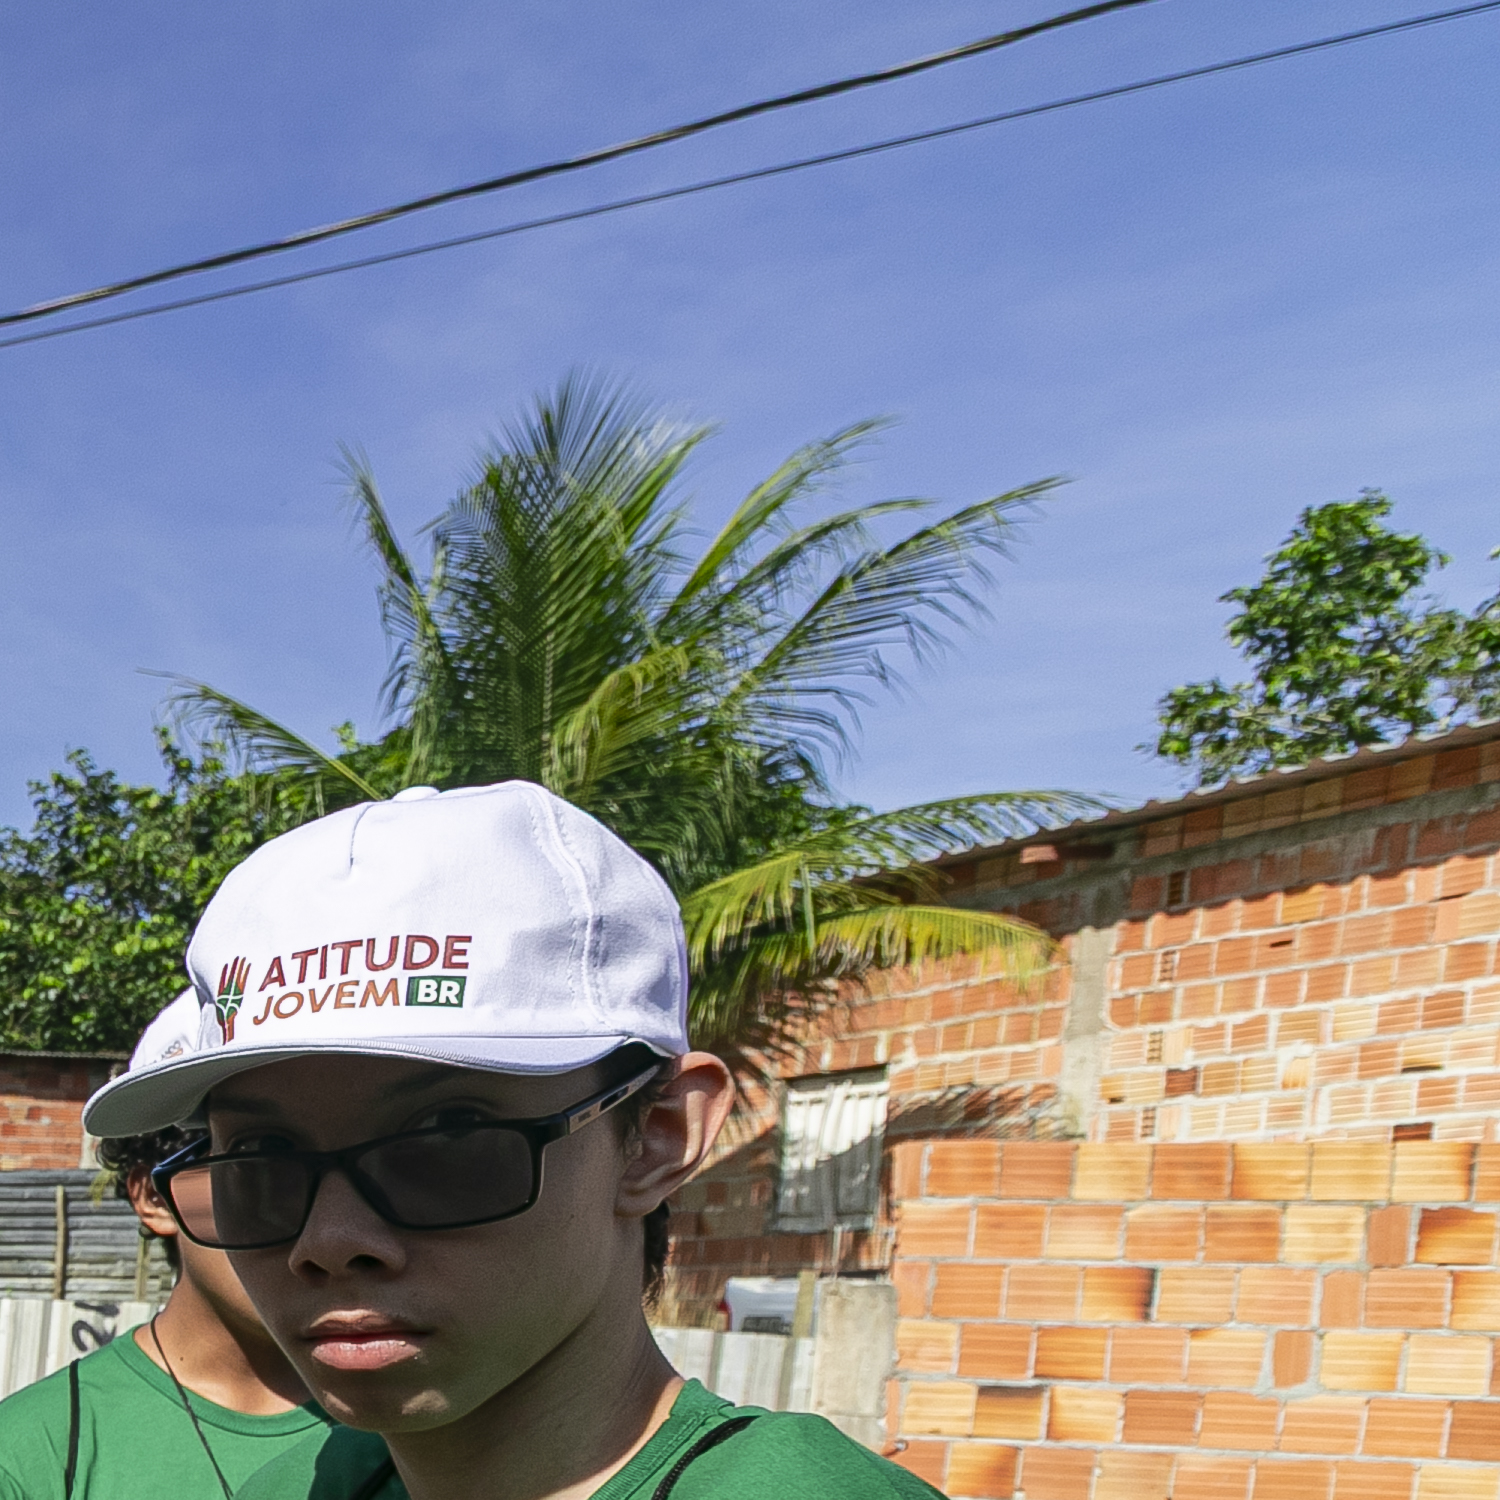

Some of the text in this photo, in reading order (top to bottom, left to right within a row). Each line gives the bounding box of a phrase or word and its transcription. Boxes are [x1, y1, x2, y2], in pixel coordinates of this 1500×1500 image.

[258, 935, 472, 992] ATITUDE
[253, 978, 461, 1025] JOVEM BR
